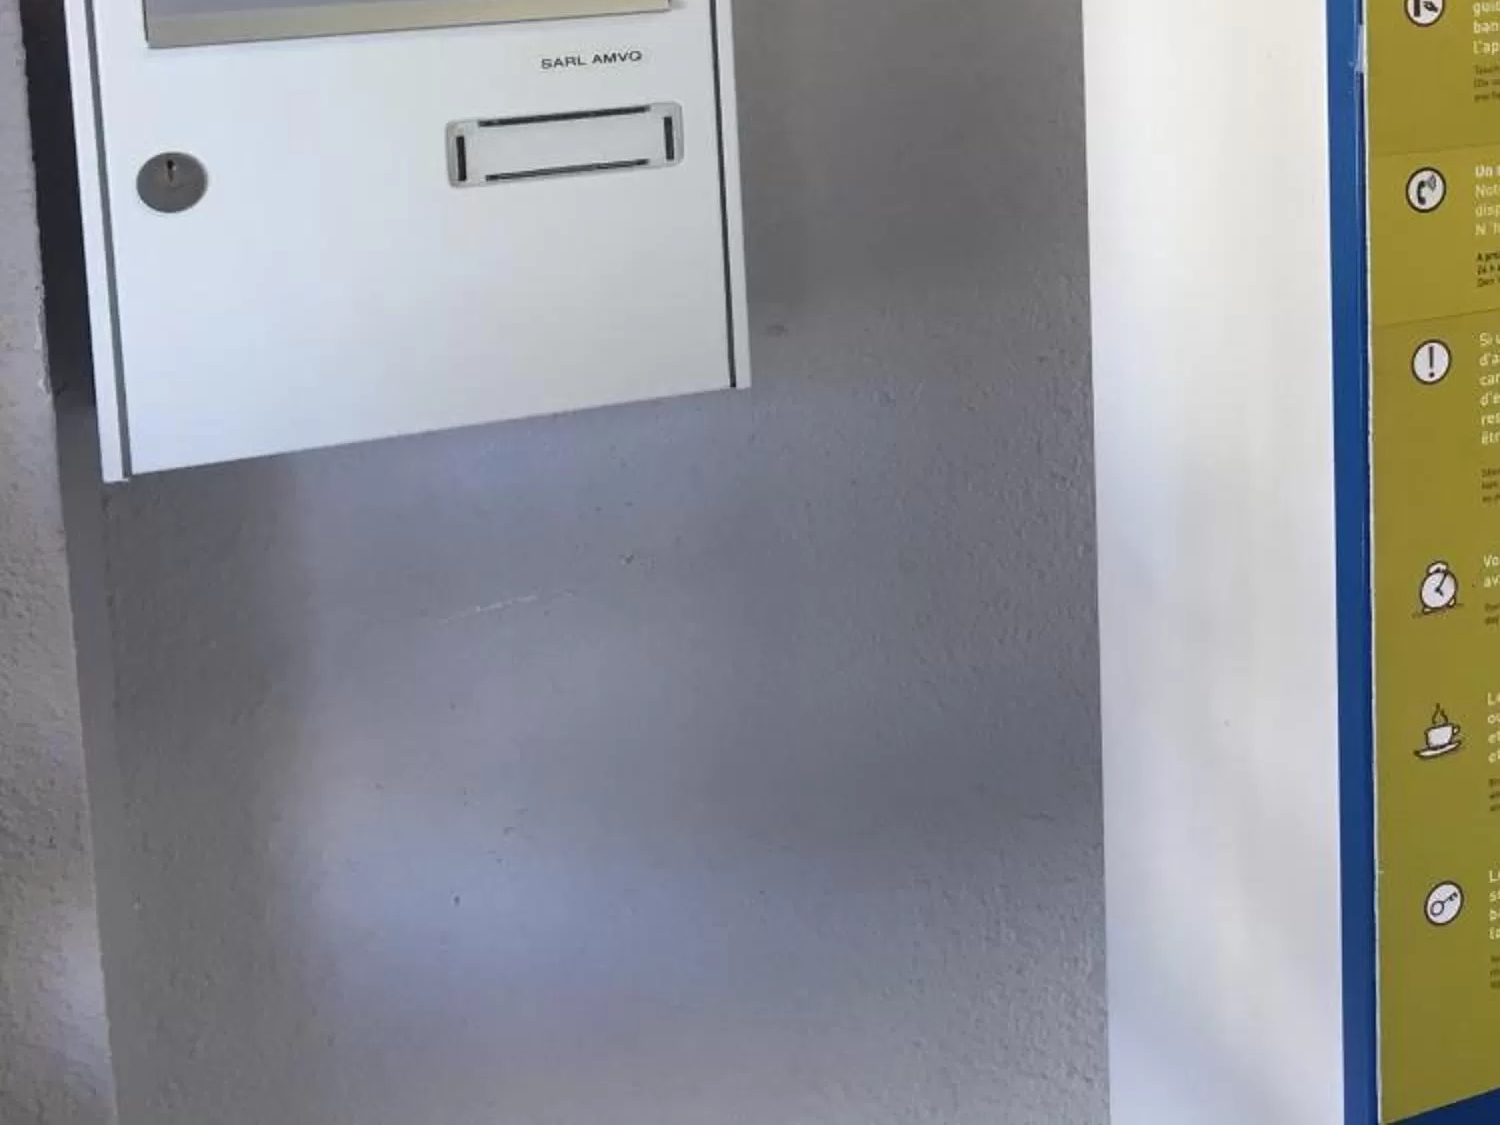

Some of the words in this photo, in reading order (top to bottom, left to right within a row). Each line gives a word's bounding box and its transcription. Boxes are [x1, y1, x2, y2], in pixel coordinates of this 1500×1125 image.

[541, 54, 586, 69] SARL
[1475, 165, 1492, 178] Un
[1479, 333, 1493, 347] Si
